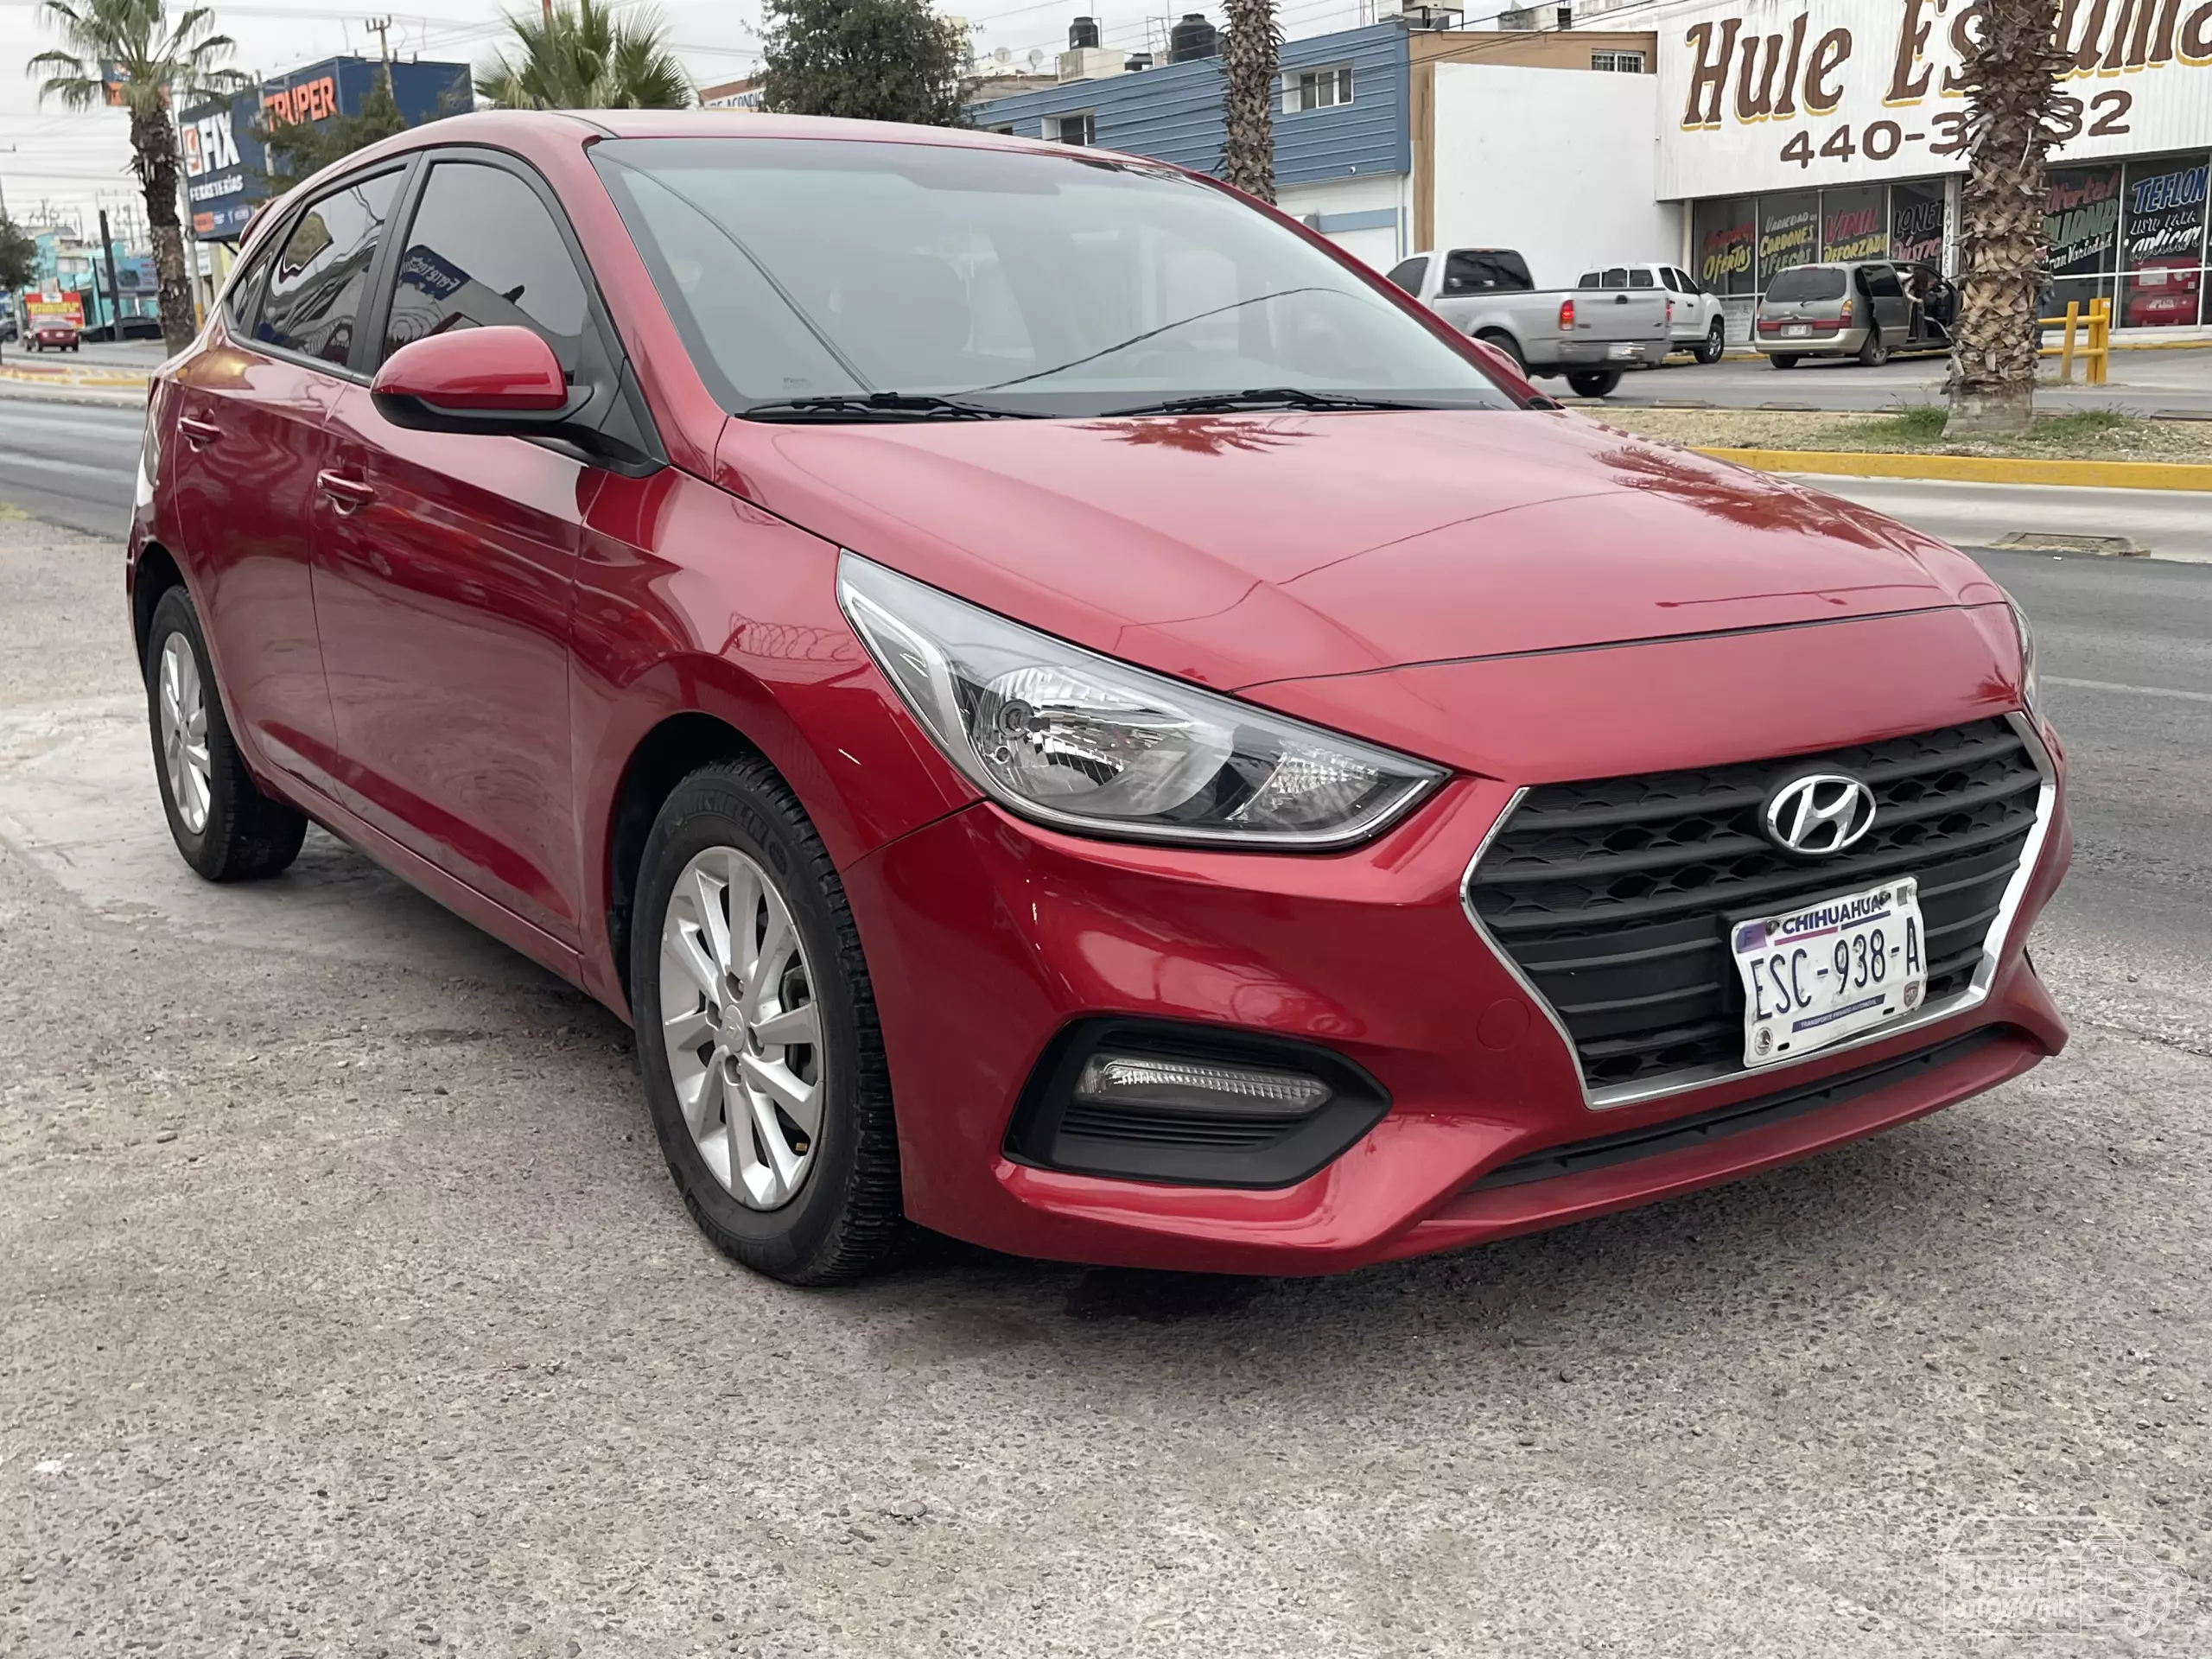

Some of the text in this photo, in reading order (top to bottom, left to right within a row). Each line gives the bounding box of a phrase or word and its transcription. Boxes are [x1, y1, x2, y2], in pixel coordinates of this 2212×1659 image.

[1681, 13, 1850, 130] Hule
[264, 76, 338, 132] TRUPER
[198, 111, 240, 174] FIX
[2132, 165, 2209, 214] TEFLON
[1759, 225, 1814, 257] CORDONES
[1825, 205, 1878, 245] VINIL
[1782, 894, 1881, 934] CHIHUAHUA
[1751, 917, 1919, 1021] ESC-938-A
